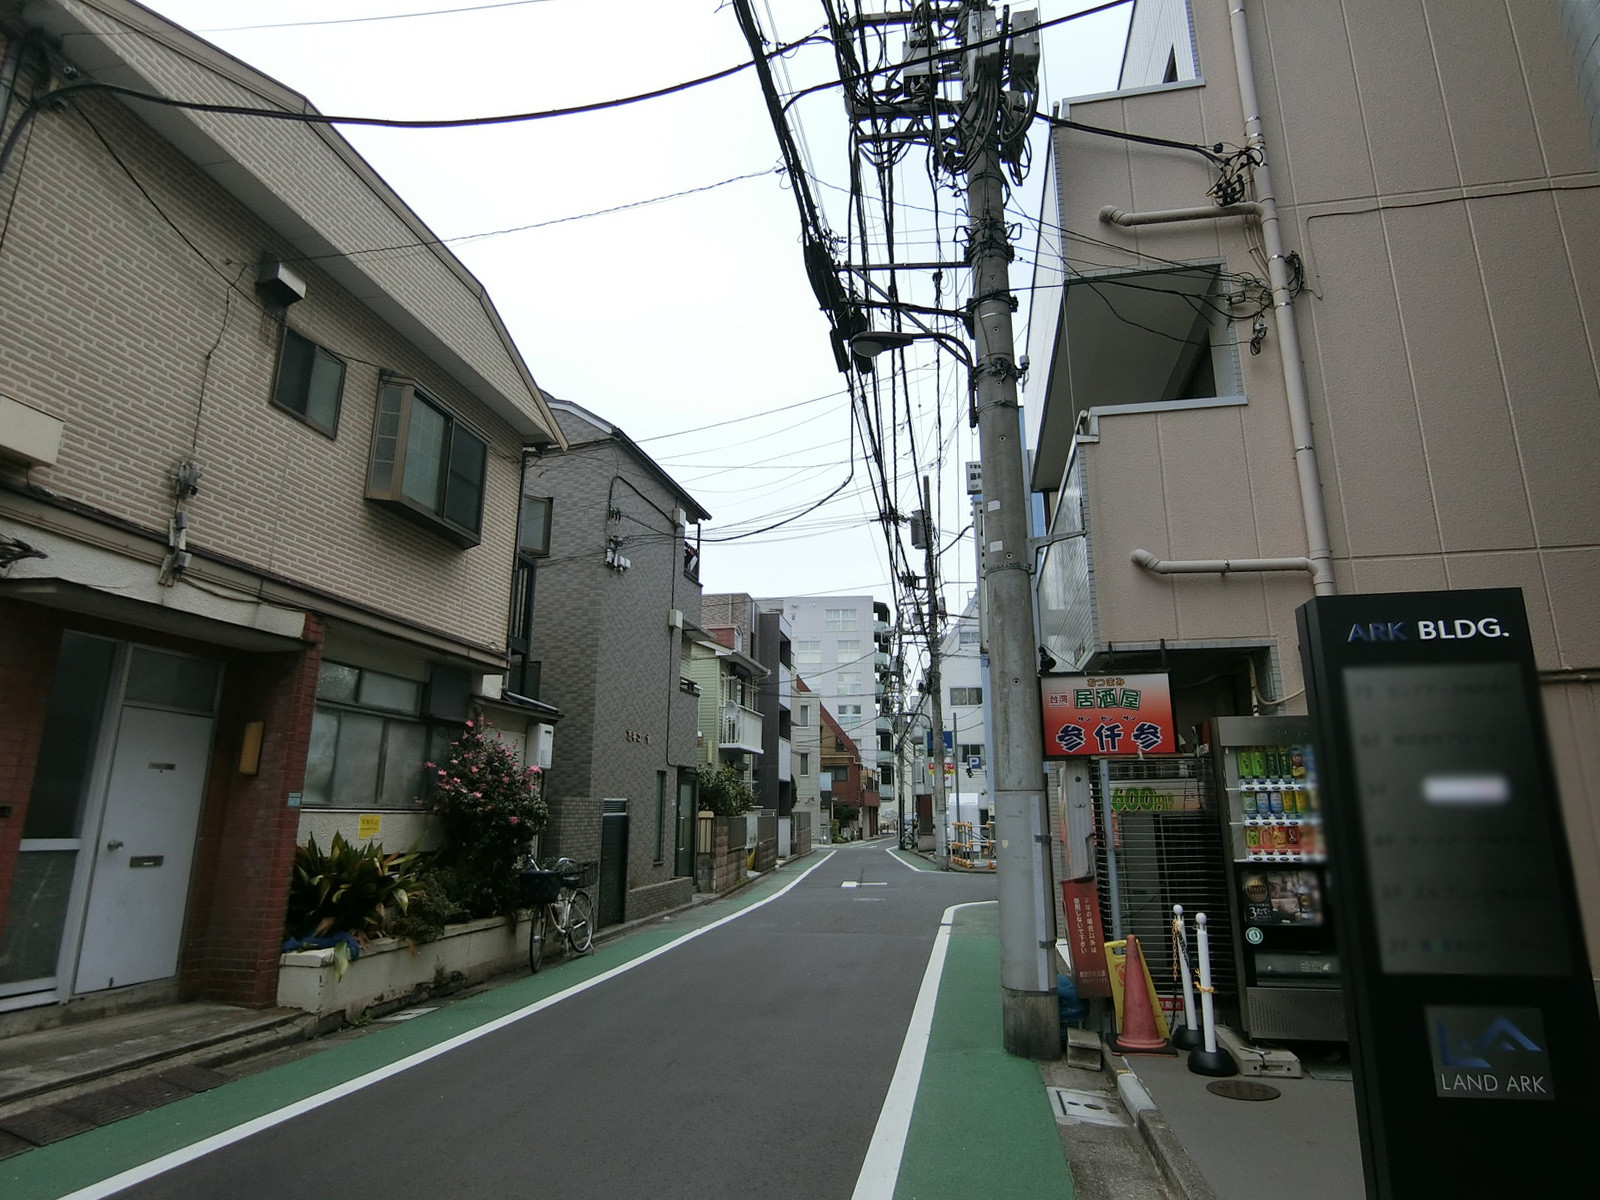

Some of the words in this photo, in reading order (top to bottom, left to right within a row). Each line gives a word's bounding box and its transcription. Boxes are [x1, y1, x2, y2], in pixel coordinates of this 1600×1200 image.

[1347, 621, 1410, 642] ARK
[1417, 617, 1510, 640] BLDG.
[1086, 677, 1125, 687] おつまみ
[1049, 695, 1068, 704] 台湾
[1073, 688, 1141, 710] 居酒屋
[1056, 721, 1163, 753] 参仟参
[969, 757, 979, 768] P
[1441, 1073, 1498, 1091] LAND
[1506, 1075, 1547, 1094] ARK
